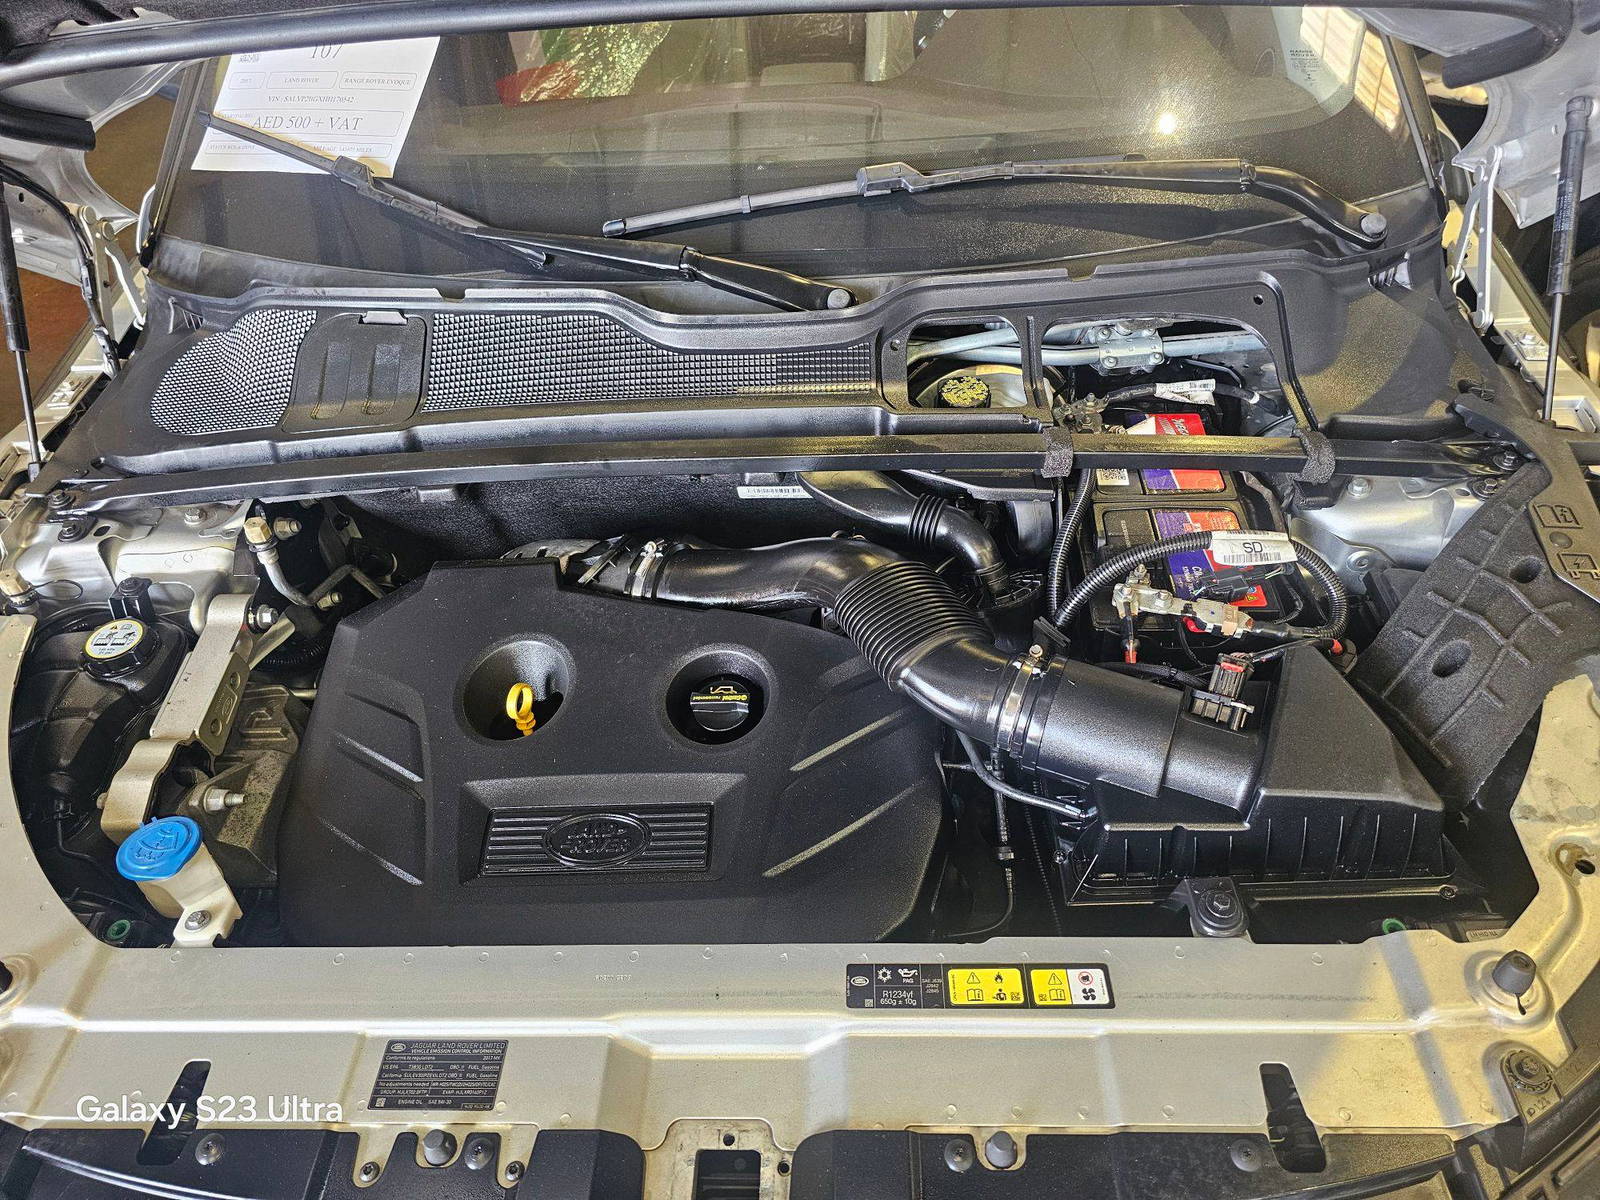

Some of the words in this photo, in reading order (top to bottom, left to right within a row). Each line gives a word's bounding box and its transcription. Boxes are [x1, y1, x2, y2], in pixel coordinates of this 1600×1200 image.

[252, 116, 284, 130] AED
[286, 116, 312, 130] 500
[314, 118, 325, 128] +
[328, 116, 363, 131] VAT
[1243, 542, 1263, 554] SD
[882, 990, 913, 999] R1234yf
